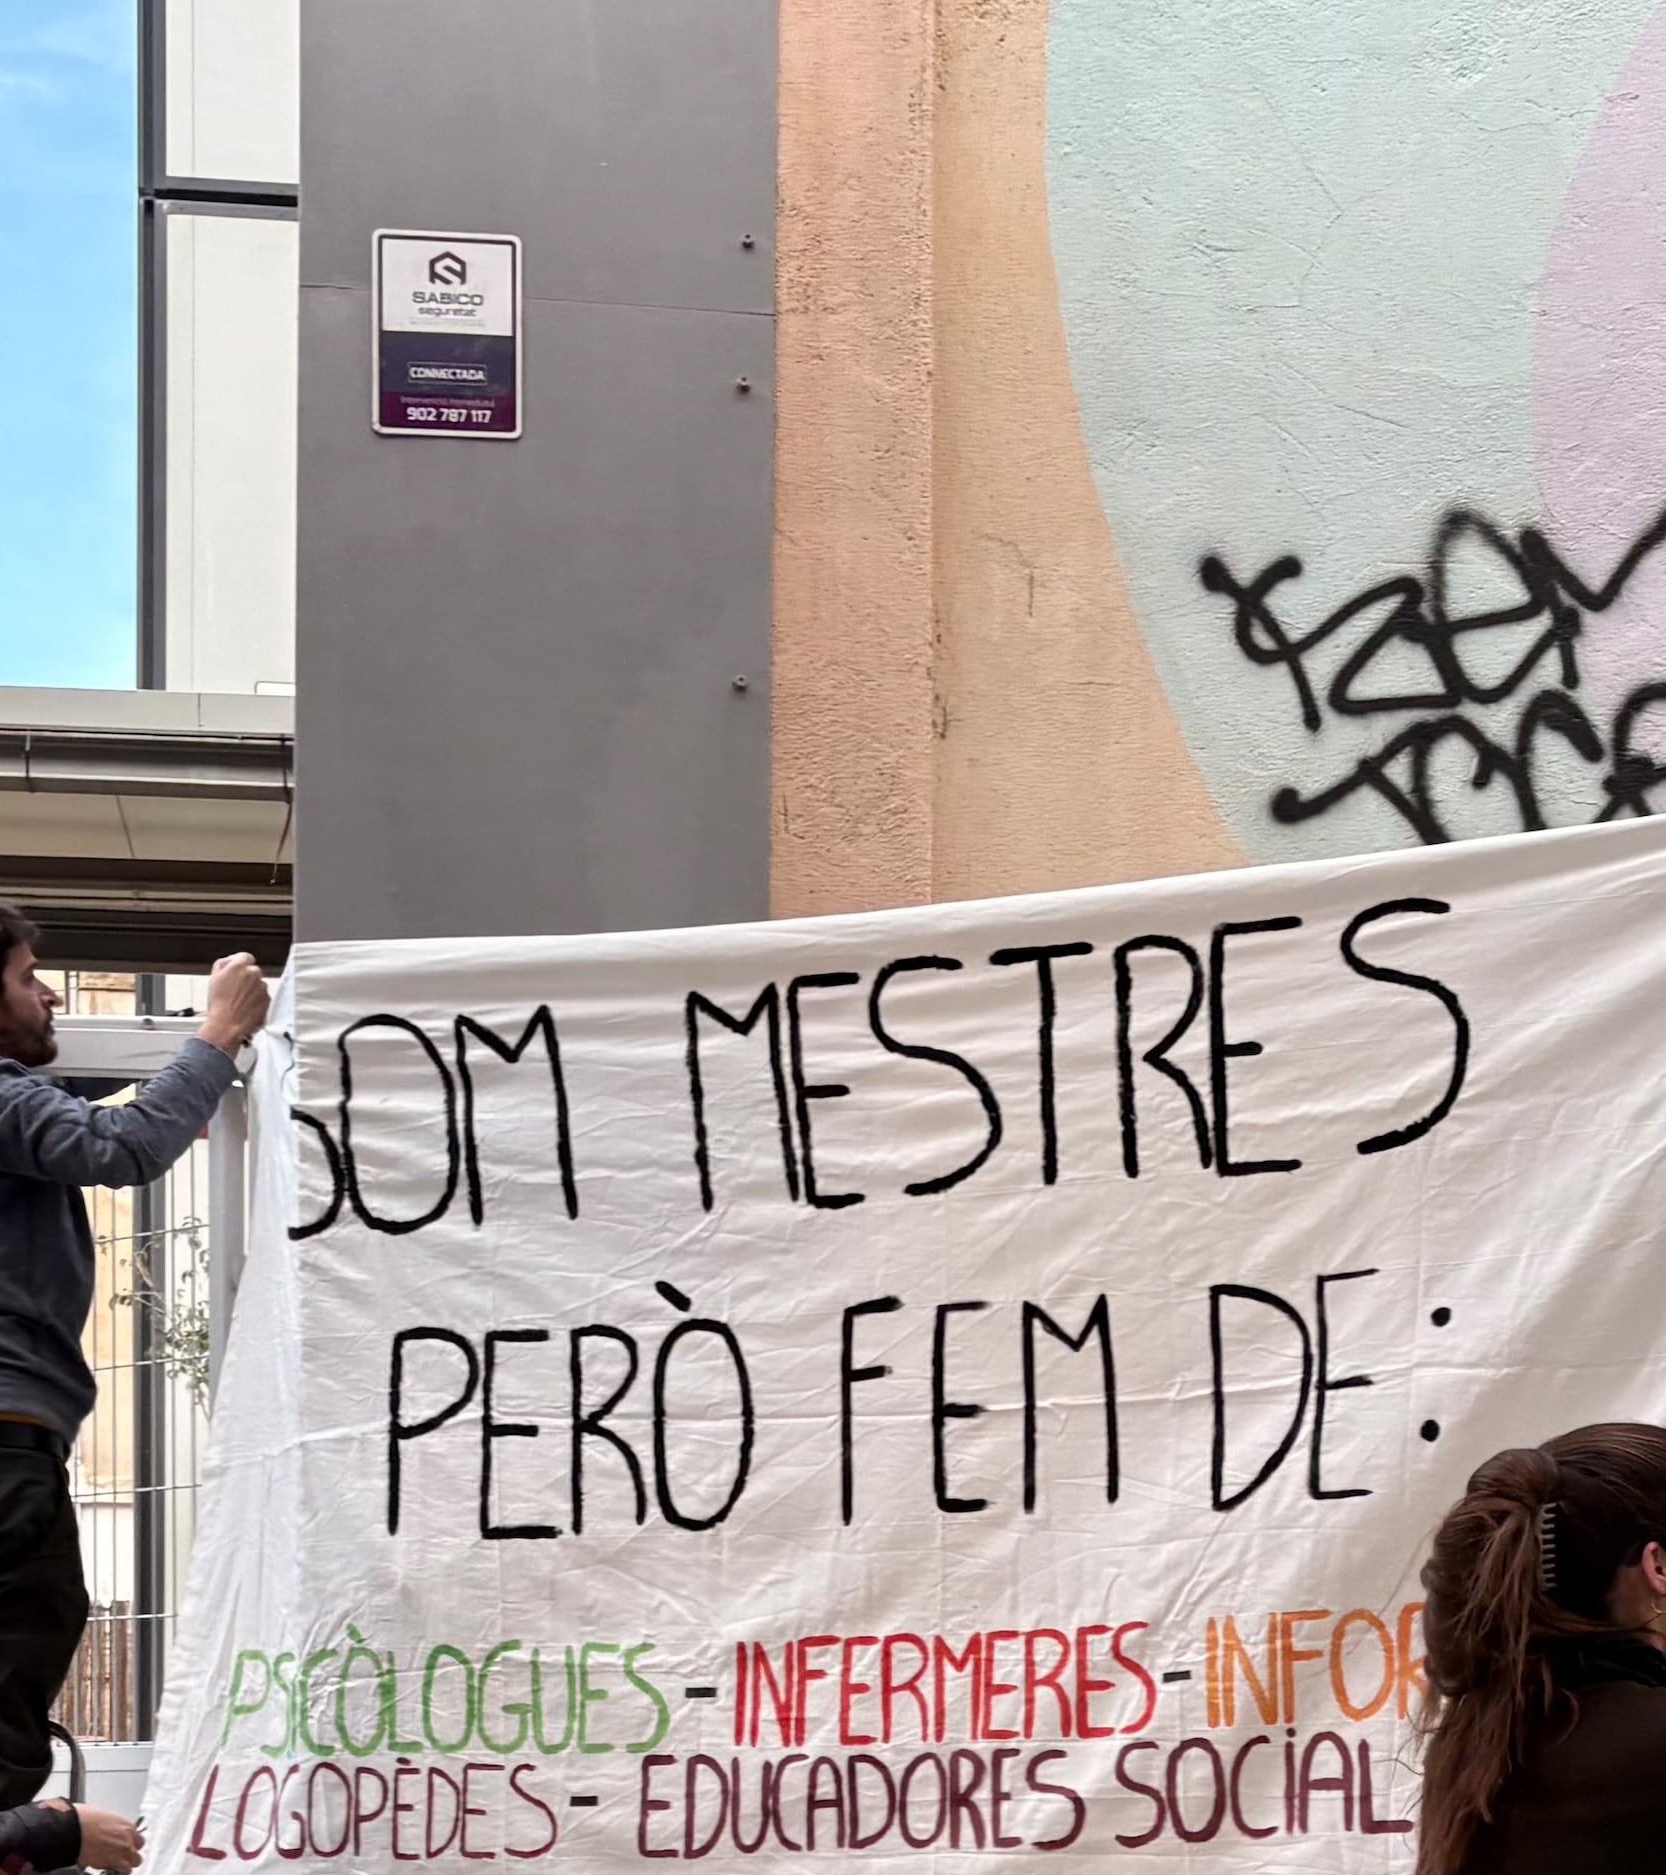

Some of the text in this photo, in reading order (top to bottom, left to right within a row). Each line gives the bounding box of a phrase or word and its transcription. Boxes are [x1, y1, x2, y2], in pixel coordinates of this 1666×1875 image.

[412, 291, 484, 306] SABICO
[409, 366, 486, 380] CONNECTADA
[406, 407, 492, 423] 902 787 117
[685, 896, 1470, 1212] MESTRES
[388, 1280, 755, 1540] PERÒ
[839, 1292, 1120, 1526] FEM
[637, 1746, 1088, 1860] EDUCADORES
